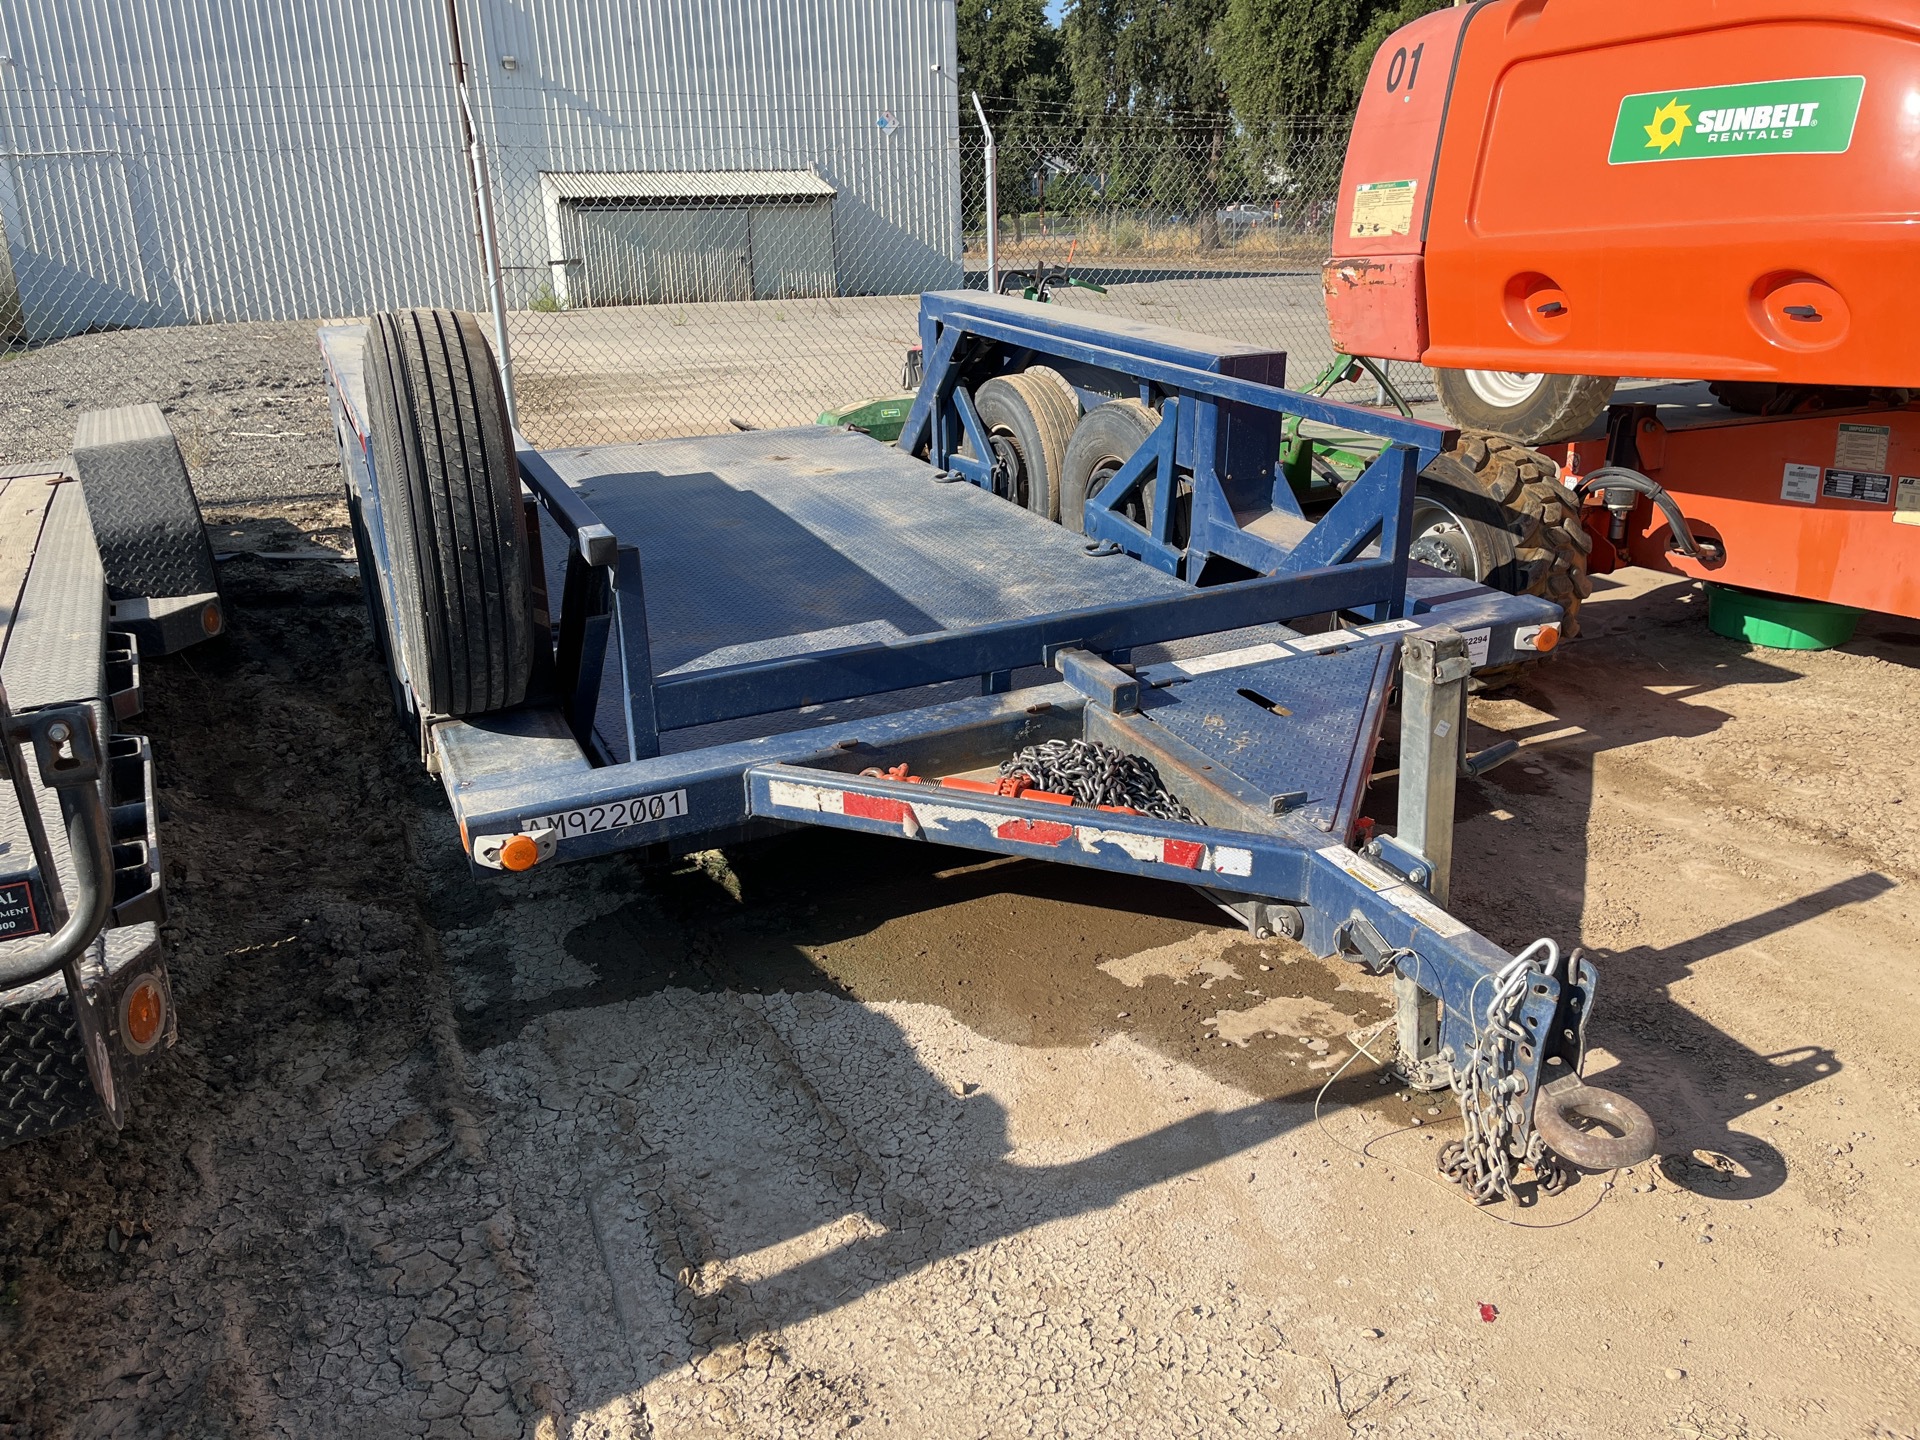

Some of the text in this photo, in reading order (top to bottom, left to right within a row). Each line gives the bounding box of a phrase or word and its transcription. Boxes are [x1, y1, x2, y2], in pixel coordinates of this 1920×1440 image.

[1386, 42, 1425, 94] 01
[1695, 102, 1819, 133] SUNBELT
[1707, 129, 1794, 142] RENTALS
[1848, 425, 1880, 433] IMPORTANT
